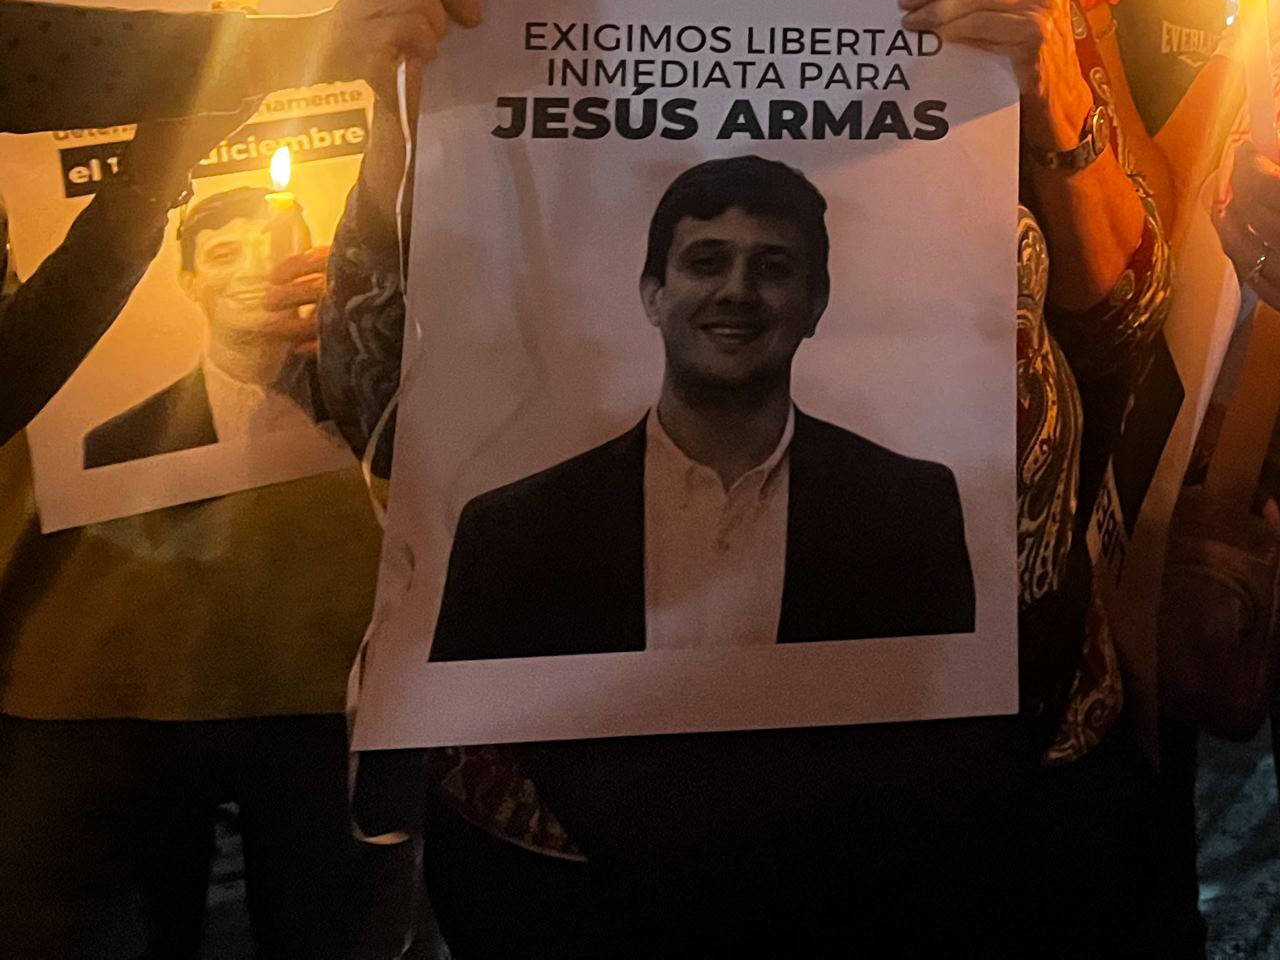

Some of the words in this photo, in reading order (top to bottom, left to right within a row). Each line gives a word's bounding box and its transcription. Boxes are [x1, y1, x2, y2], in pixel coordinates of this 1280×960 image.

[523, 22, 732, 54] EXIGIMOS
[747, 26, 944, 58] LIBERTAD
[547, 57, 786, 90] INMEDIATA
[799, 62, 911, 91] PARA
[491, 83, 699, 141] JESÚS
[716, 99, 950, 142] ARMAS
[68, 158, 102, 184] el
